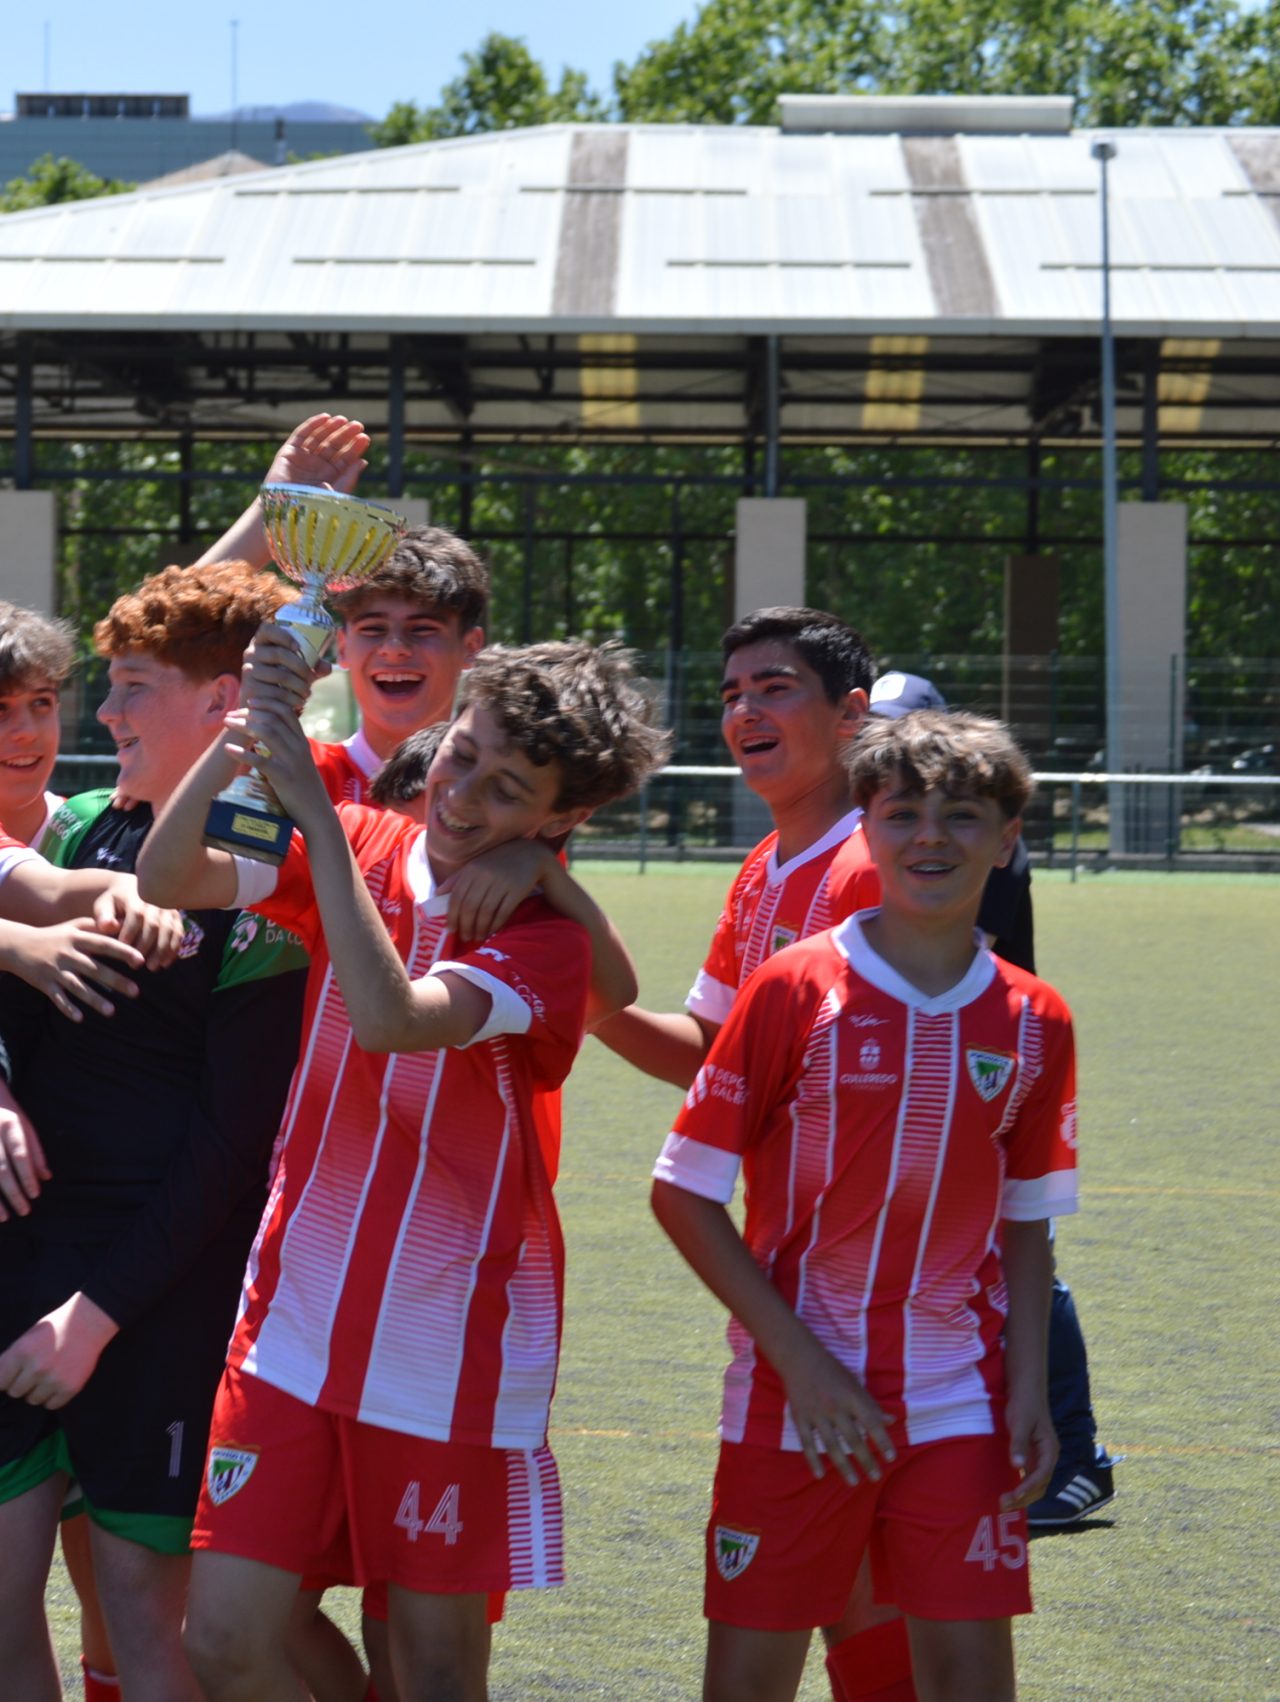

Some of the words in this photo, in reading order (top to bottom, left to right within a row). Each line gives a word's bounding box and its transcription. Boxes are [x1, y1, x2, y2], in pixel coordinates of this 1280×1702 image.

[265, 929, 284, 944] DA
[165, 1420, 184, 1478] 1
[393, 1480, 464, 1546] 44
[964, 1511, 1026, 1572] 45
